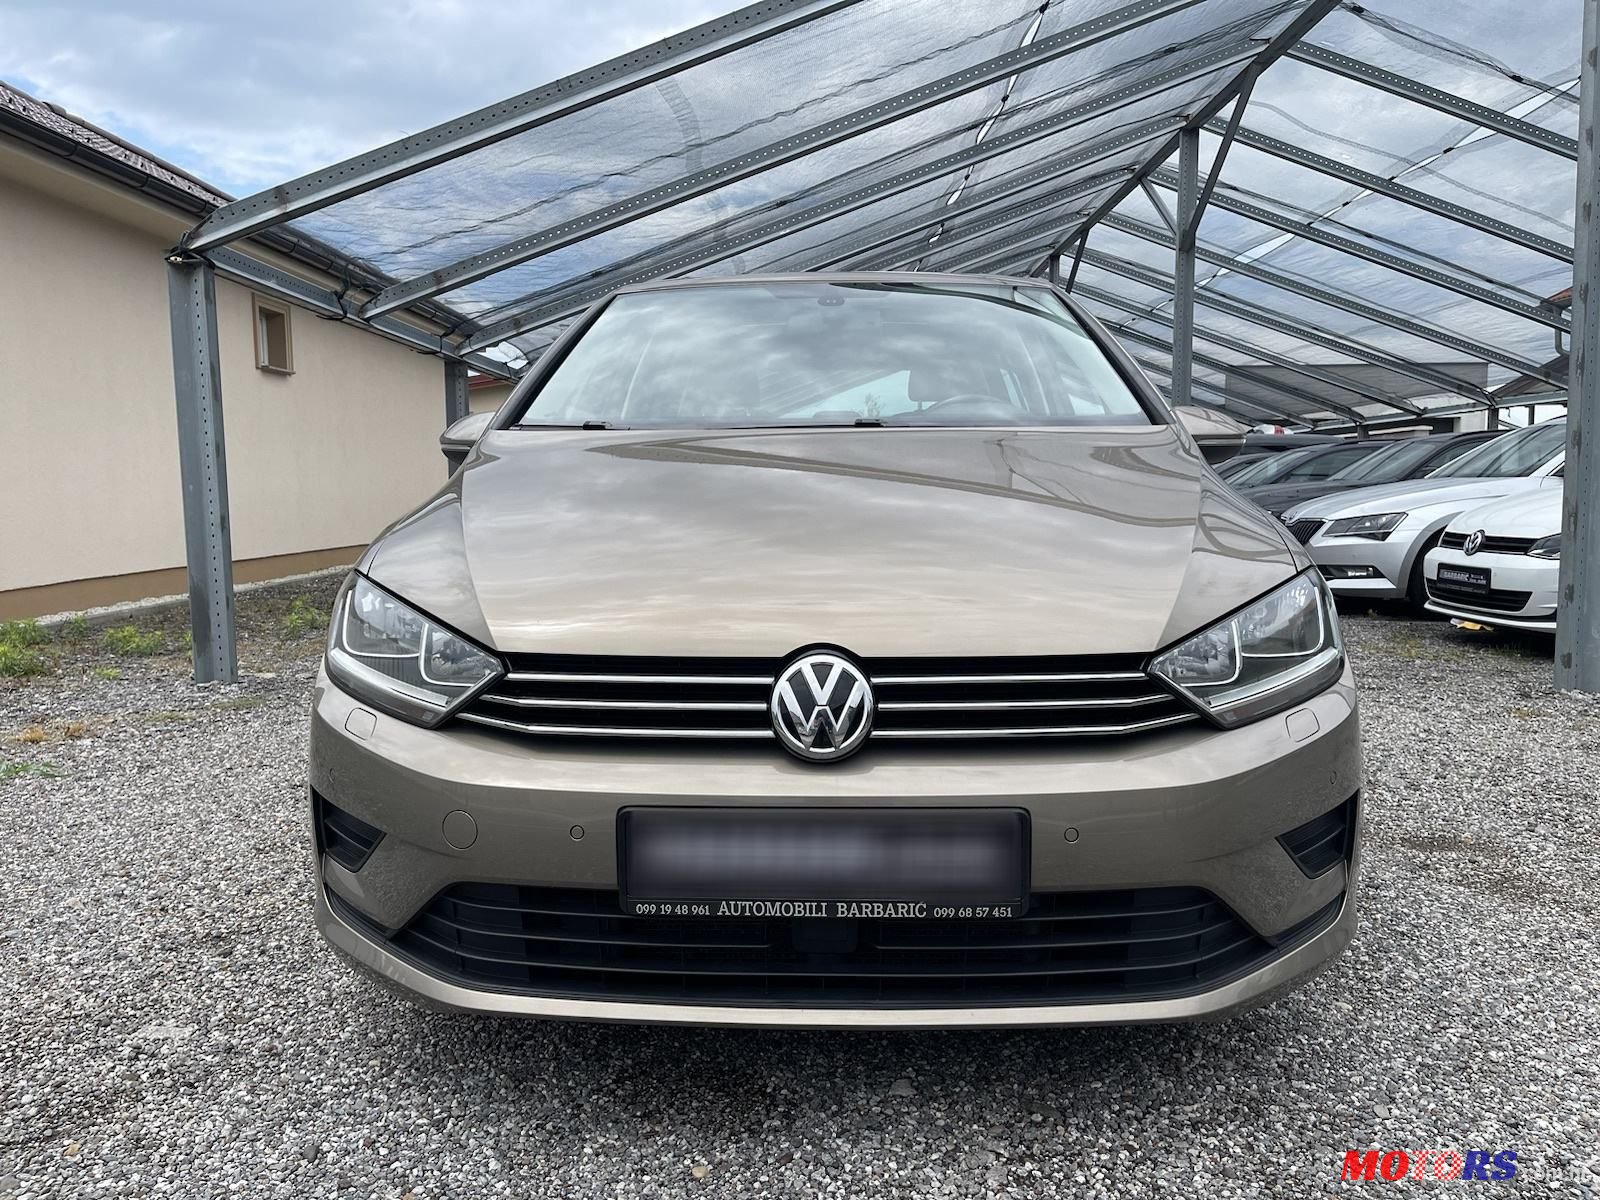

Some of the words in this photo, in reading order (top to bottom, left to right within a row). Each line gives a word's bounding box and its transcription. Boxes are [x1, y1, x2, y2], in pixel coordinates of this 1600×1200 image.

[635, 904, 656, 915] 099
[660, 904, 672, 915] 19
[674, 904, 689, 915] 48
[691, 904, 710, 916] 961
[717, 901, 828, 917] AUTOMOBILI
[933, 907, 955, 918] 099
[958, 907, 973, 918] 68
[975, 907, 989, 918] 57
[992, 907, 1012, 918] 451
